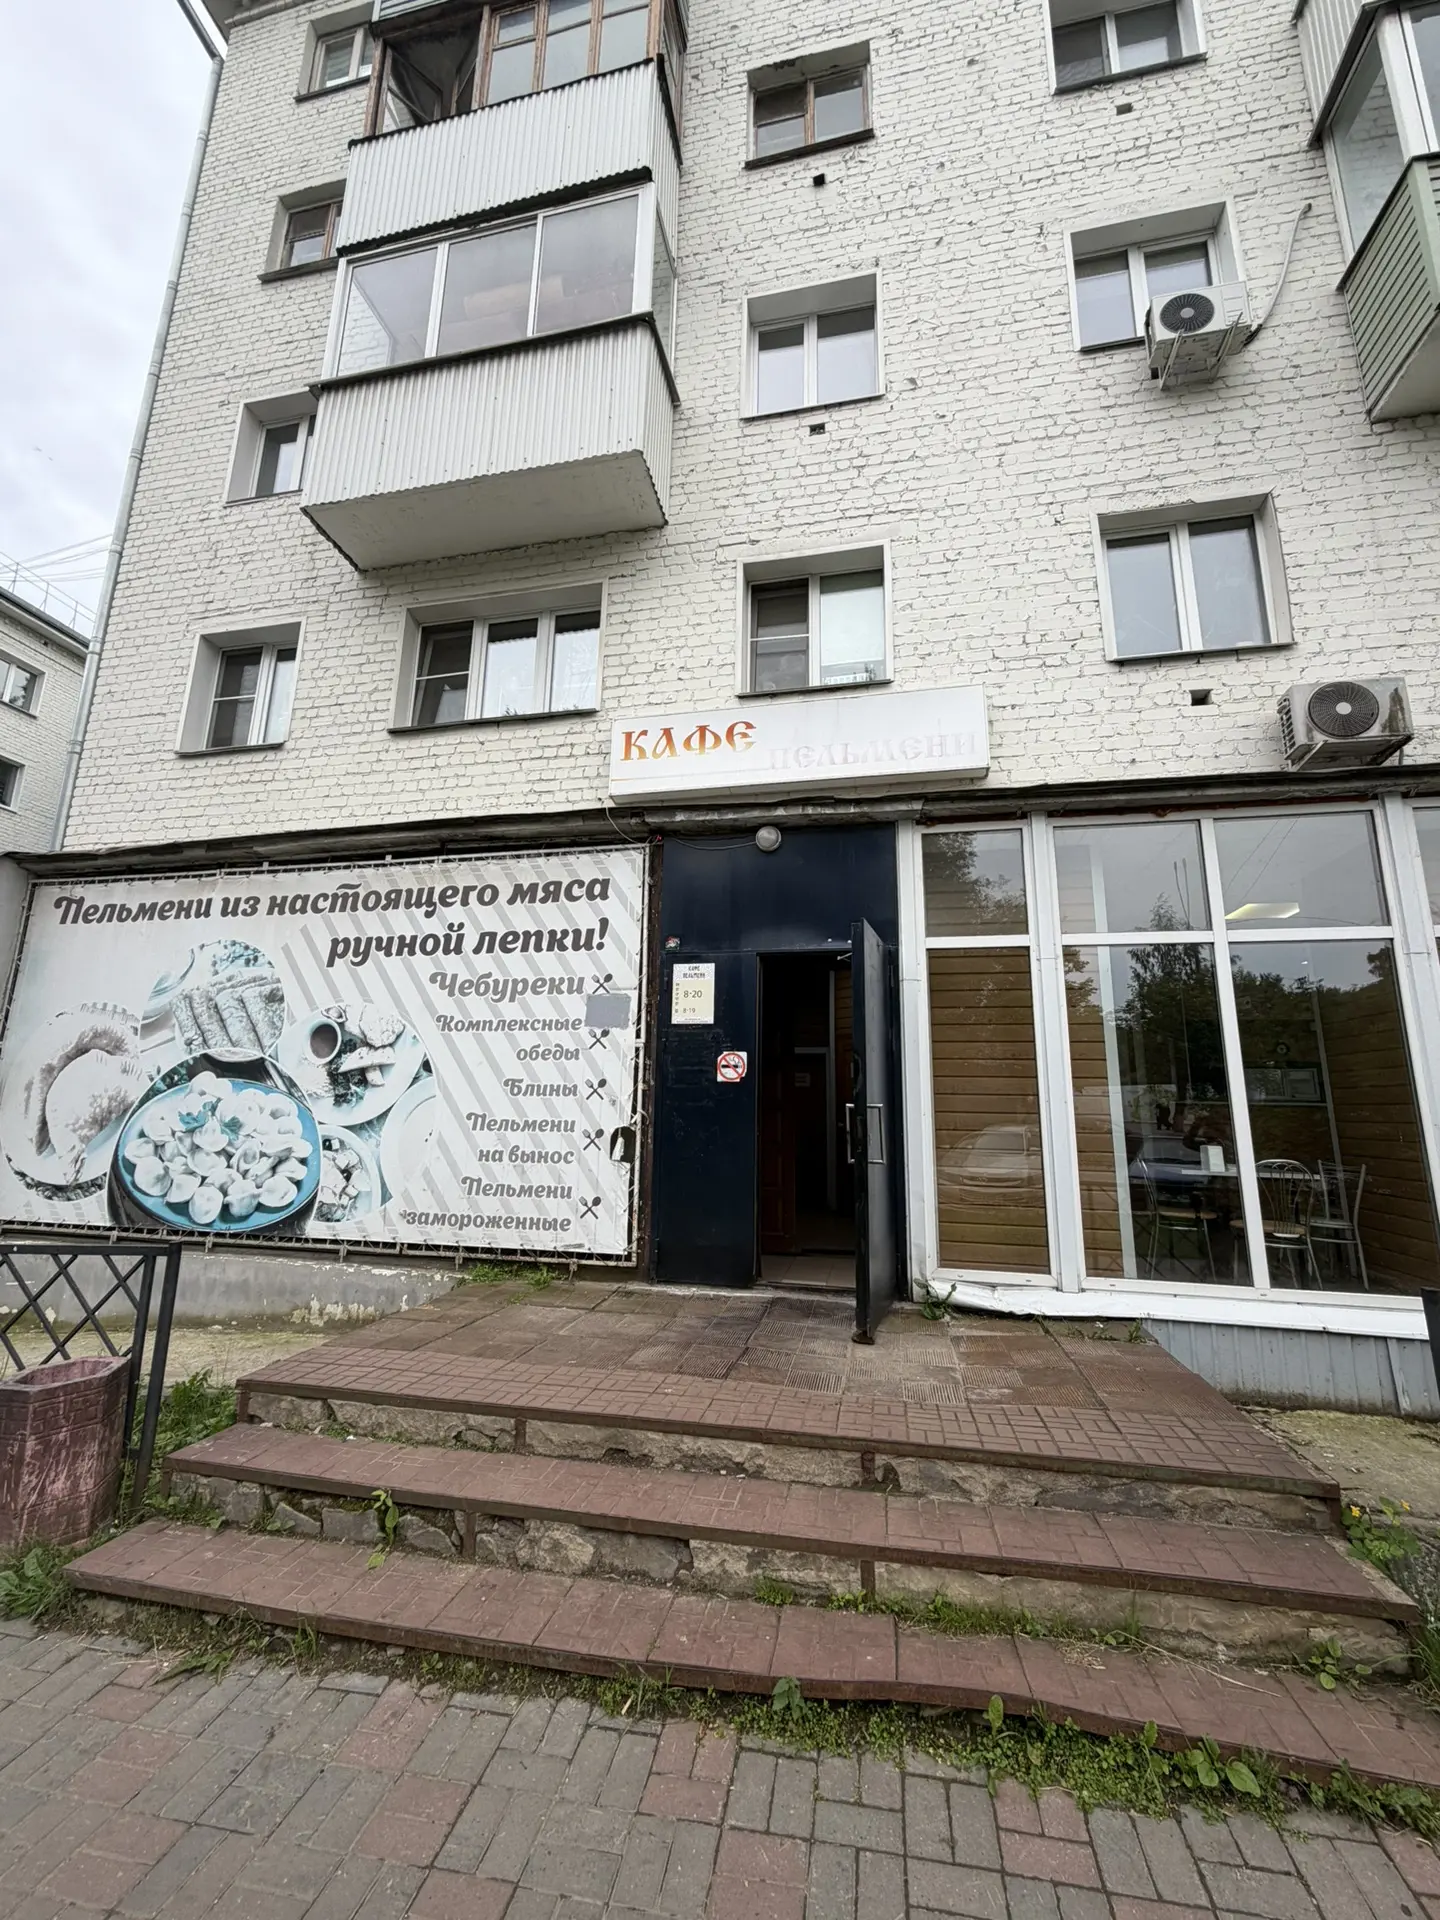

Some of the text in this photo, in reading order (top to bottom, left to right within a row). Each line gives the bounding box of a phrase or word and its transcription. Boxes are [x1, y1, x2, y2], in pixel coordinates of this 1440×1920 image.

[619, 720, 757, 762] КАФЕ
[53, 877, 611, 925] Пельмени из настоящего мяса
[325, 917, 611, 968] ручной лепки!
[428, 971, 585, 1003] Чебуреки
[435, 1014, 584, 1033] Комплексные
[516, 1043, 581, 1062] обеды
[503, 1078, 579, 1098] Блины
[465, 1111, 577, 1134] Пельмени
[477, 1145, 575, 1165] на вынос
[460, 1175, 573, 1201] Пельмени
[404, 1209, 572, 1233] замороженные
